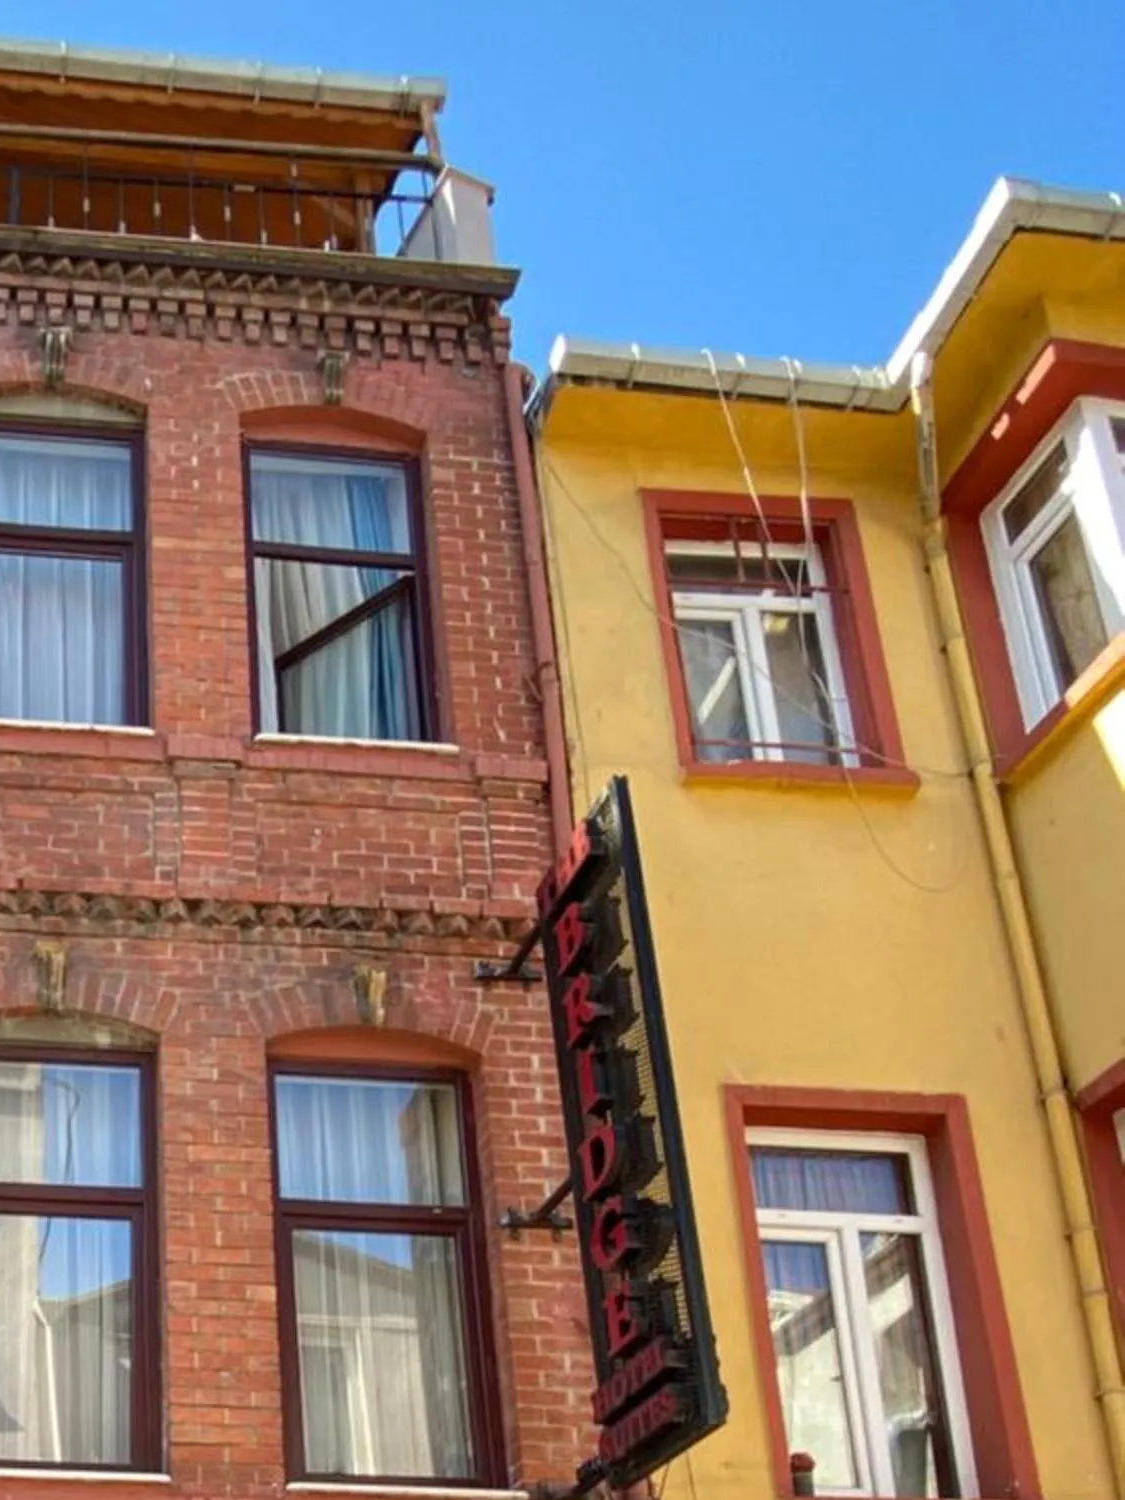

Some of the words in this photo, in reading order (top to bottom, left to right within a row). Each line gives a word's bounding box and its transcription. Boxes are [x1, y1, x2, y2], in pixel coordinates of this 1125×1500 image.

[535, 816, 591, 918] THE
[553, 900, 639, 1358] BRIDGE
[590, 1336, 665, 1424] HOTEL
